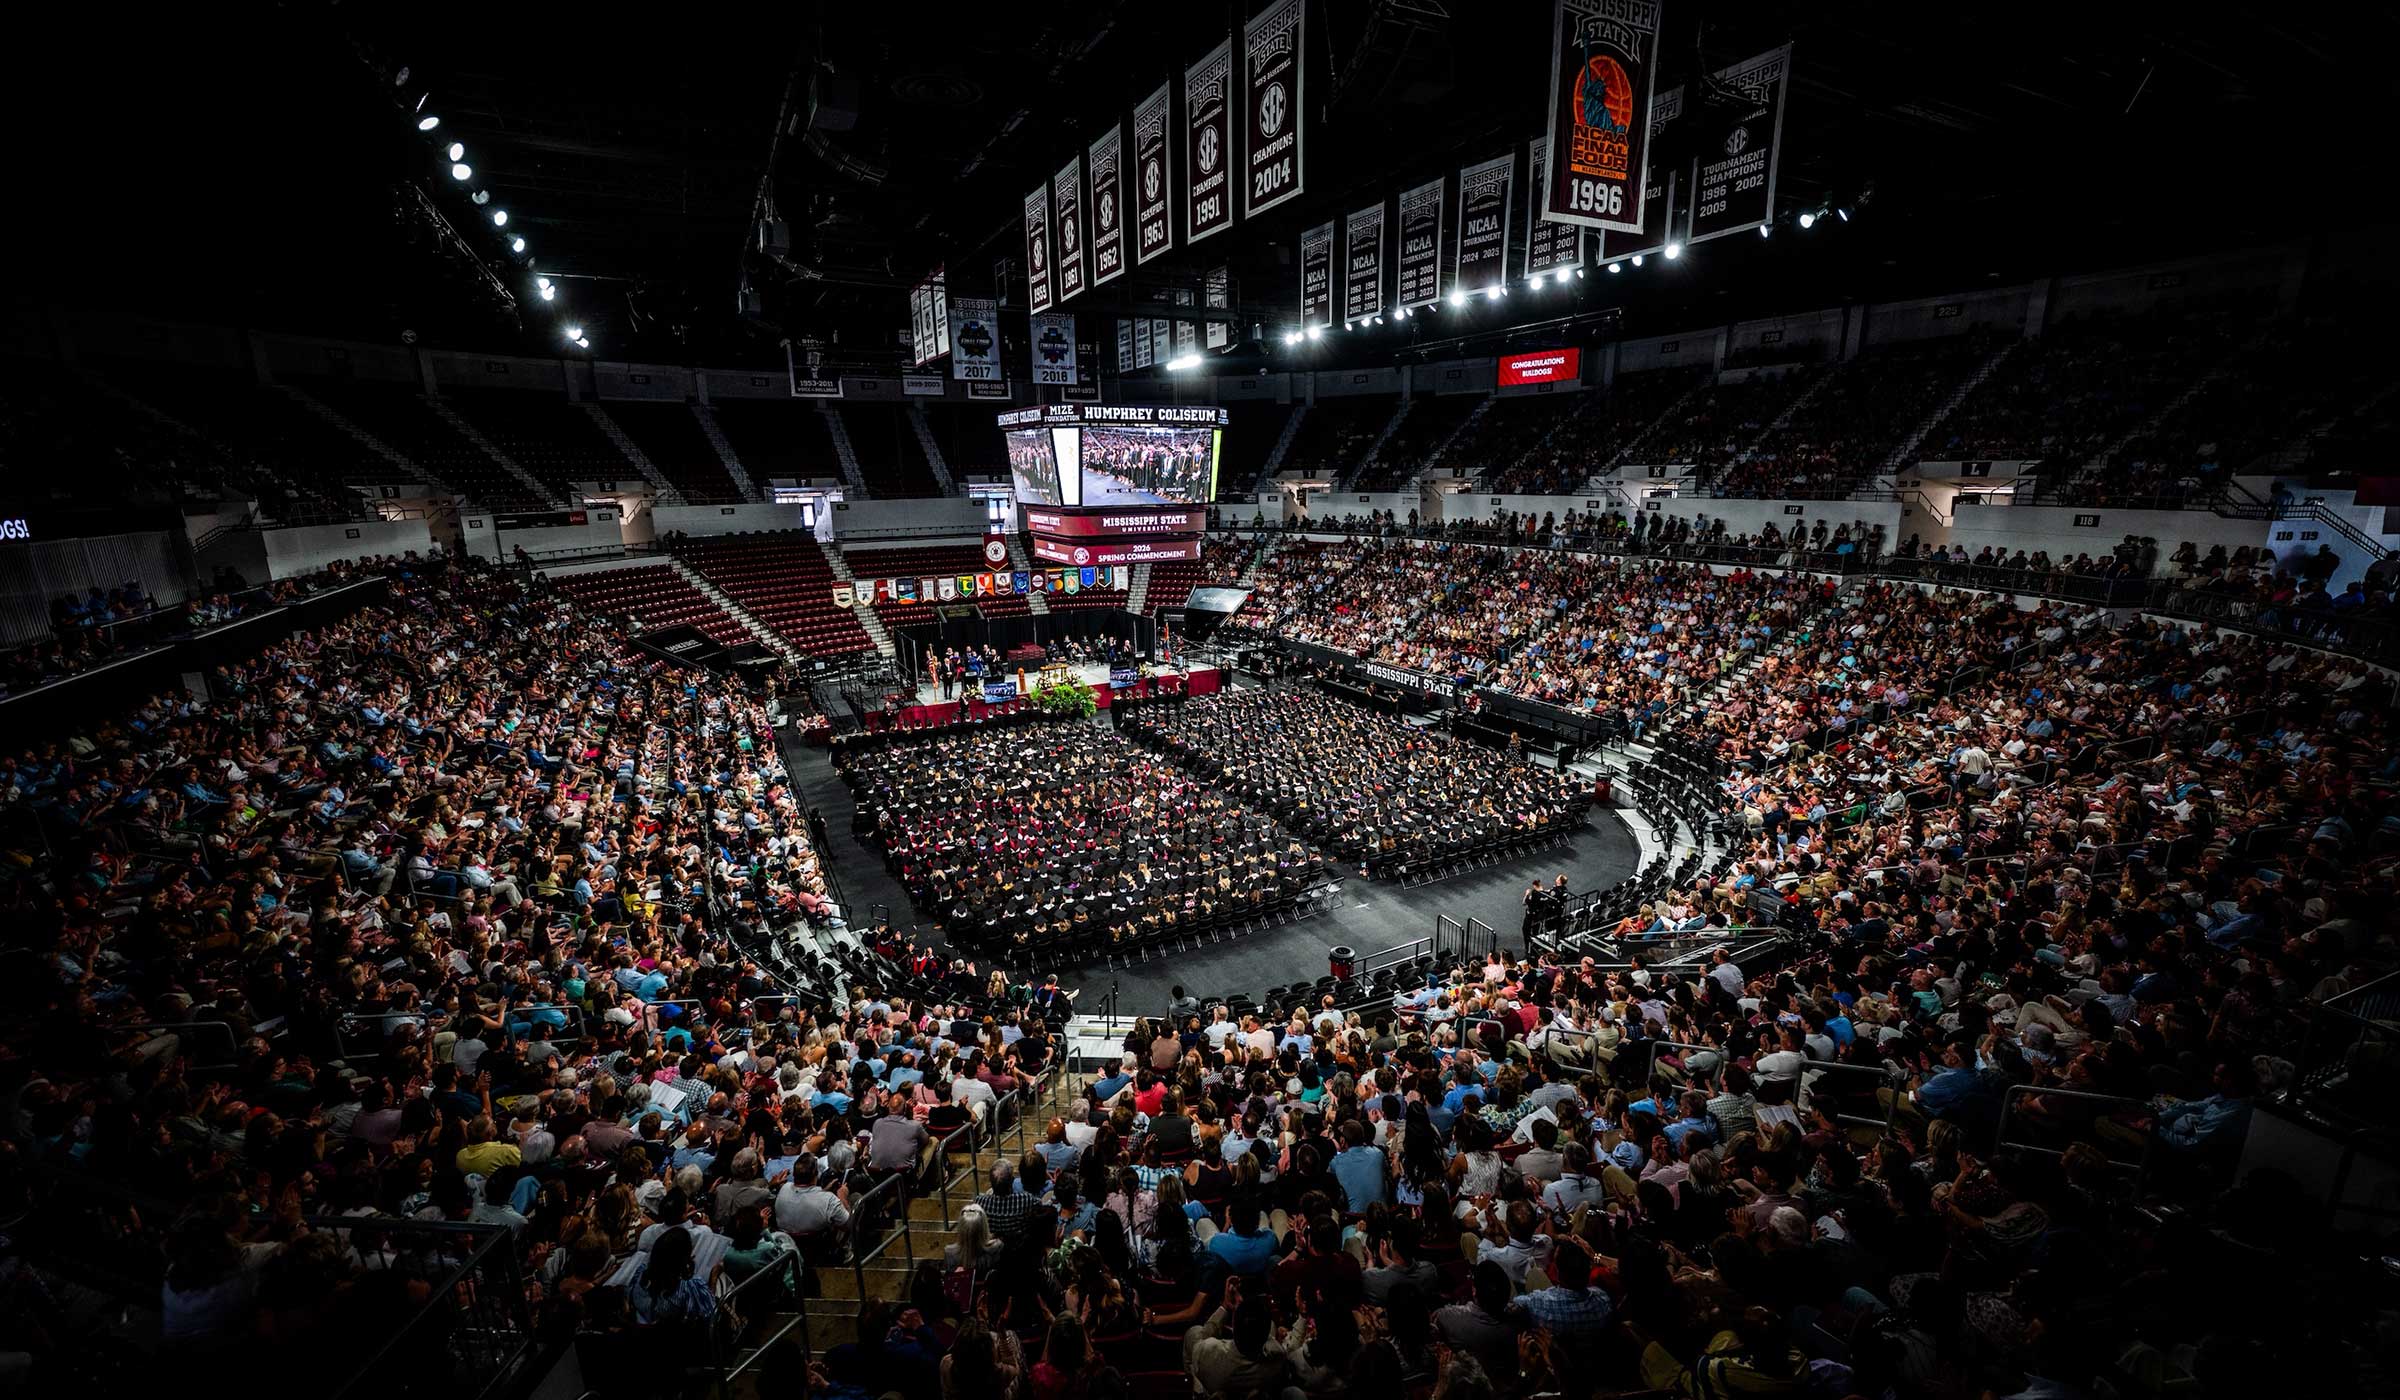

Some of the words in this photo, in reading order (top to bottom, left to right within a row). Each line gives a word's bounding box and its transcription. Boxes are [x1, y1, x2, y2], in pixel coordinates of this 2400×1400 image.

[1249, 1, 1300, 52] MISSISSIPPI
[1588, 21, 1629, 50] STATE
[1261, 36, 1285, 63] STATE
[1199, 85, 1218, 107] STATE
[1261, 86, 1284, 134] SEC
[1574, 123, 1627, 146] NCAA
[1199, 127, 1217, 172] SEC
[1253, 132, 1293, 166] CHAMPIONS
[1573, 136, 1627, 158] FINAL
[1572, 149, 1627, 171] FOUR
[1703, 149, 1766, 175] TOURNAMENT
[1255, 156, 1290, 198] 2004
[1463, 166, 1510, 189] MISSISSIPPI
[1703, 160, 1764, 187] CHAMPIONS
[1193, 171, 1224, 197] CHAMPIONS
[1474, 185, 1496, 197] STATE
[1735, 174, 1764, 193] 2002
[1570, 178, 1622, 215] 1996
[1196, 195, 1220, 225] 1991
[1700, 200, 1727, 217] 2009
[1144, 220, 1164, 248] 1963
[1467, 215, 1498, 236] NCAA
[1406, 235, 1432, 254] NCAA
[1463, 232, 1501, 247] TOURNAMENT
[1534, 229, 1552, 242] 1994
[1534, 242, 1551, 255] 2001
[1556, 236, 1574, 250] 2007
[1100, 246, 1117, 271] 1962
[1353, 253, 1375, 271] NCAA
[1462, 252, 1479, 264] 2024
[1533, 255, 1551, 267] 2010
[1556, 250, 1574, 262] 2012
[1307, 268, 1326, 285] NCAA
[964, 366, 991, 378] 2017
[1511, 356, 1565, 369] CONGRATULATIONS
[1043, 371, 1067, 382] 2018
[1522, 368, 1552, 377] BULLDOGS!
[1044, 414, 1080, 422] FOUNDATION
[1050, 405, 1073, 415] MIZE
[1084, 406, 1153, 420] HUMPHREY
[1158, 408, 1216, 422] COLISEUM
[1654, 467, 1661, 476] K
[1971, 464, 1979, 475] L
[1103, 515, 1158, 527] MISSISSIPPI
[1160, 515, 1187, 525] STATE
[2080, 517, 2093, 525] 118
[2276, 531, 2294, 541] 118
[2301, 531, 2318, 541] 119
[1098, 554, 1126, 563] SPRING
[1127, 550, 1186, 562] COMMENCEMENT
[1367, 663, 1419, 688] MISSISSIPPI
[1424, 678, 1454, 697] STATE
